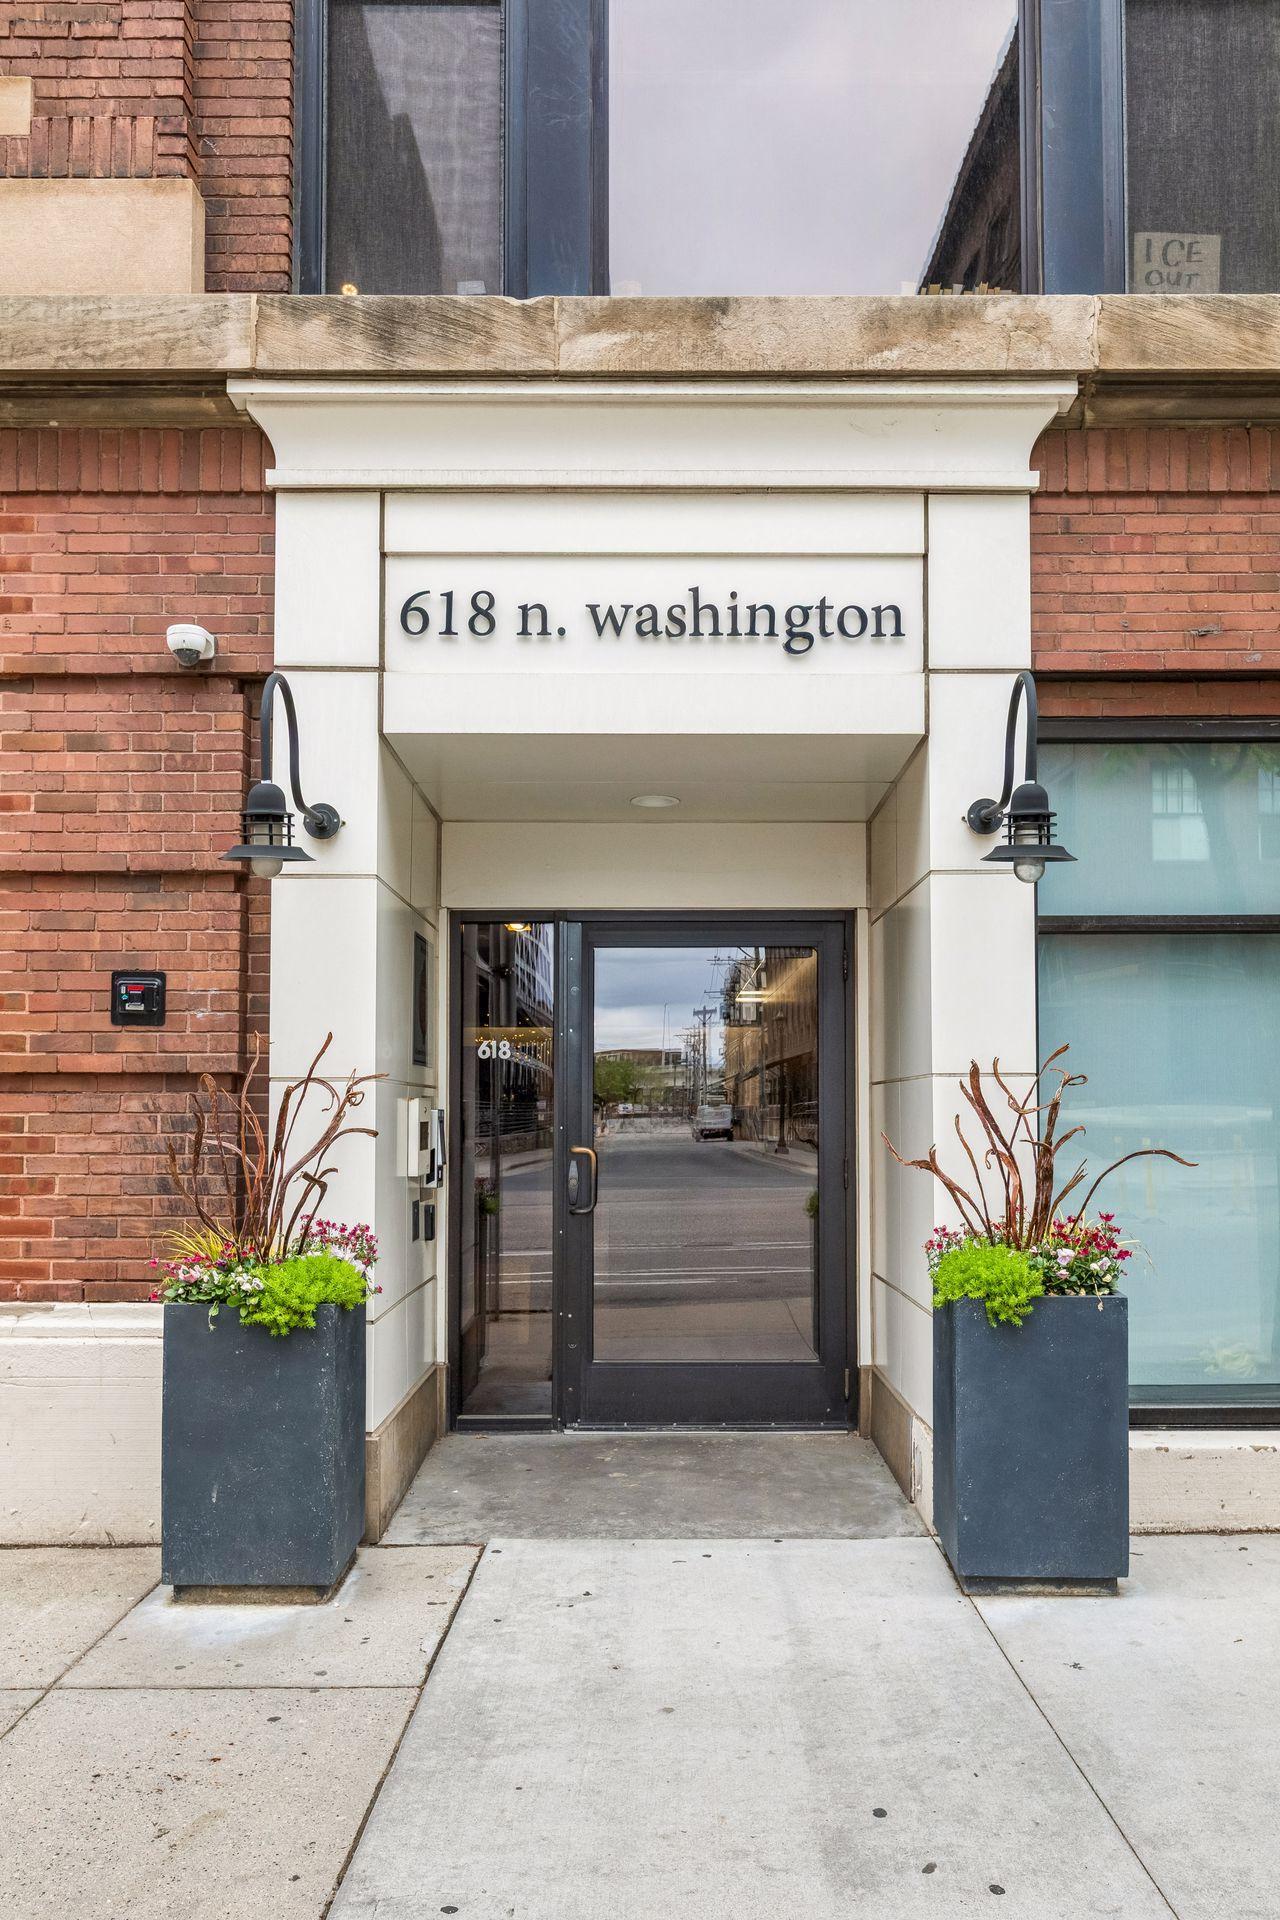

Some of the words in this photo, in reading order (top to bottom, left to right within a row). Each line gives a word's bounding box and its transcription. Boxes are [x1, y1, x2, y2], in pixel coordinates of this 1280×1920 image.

[1145, 238, 1203, 267] ICE
[400, 590, 496, 637] 618
[516, 602, 566, 637] n.
[585, 586, 906, 655] washington
[477, 1040, 511, 1060] 618
